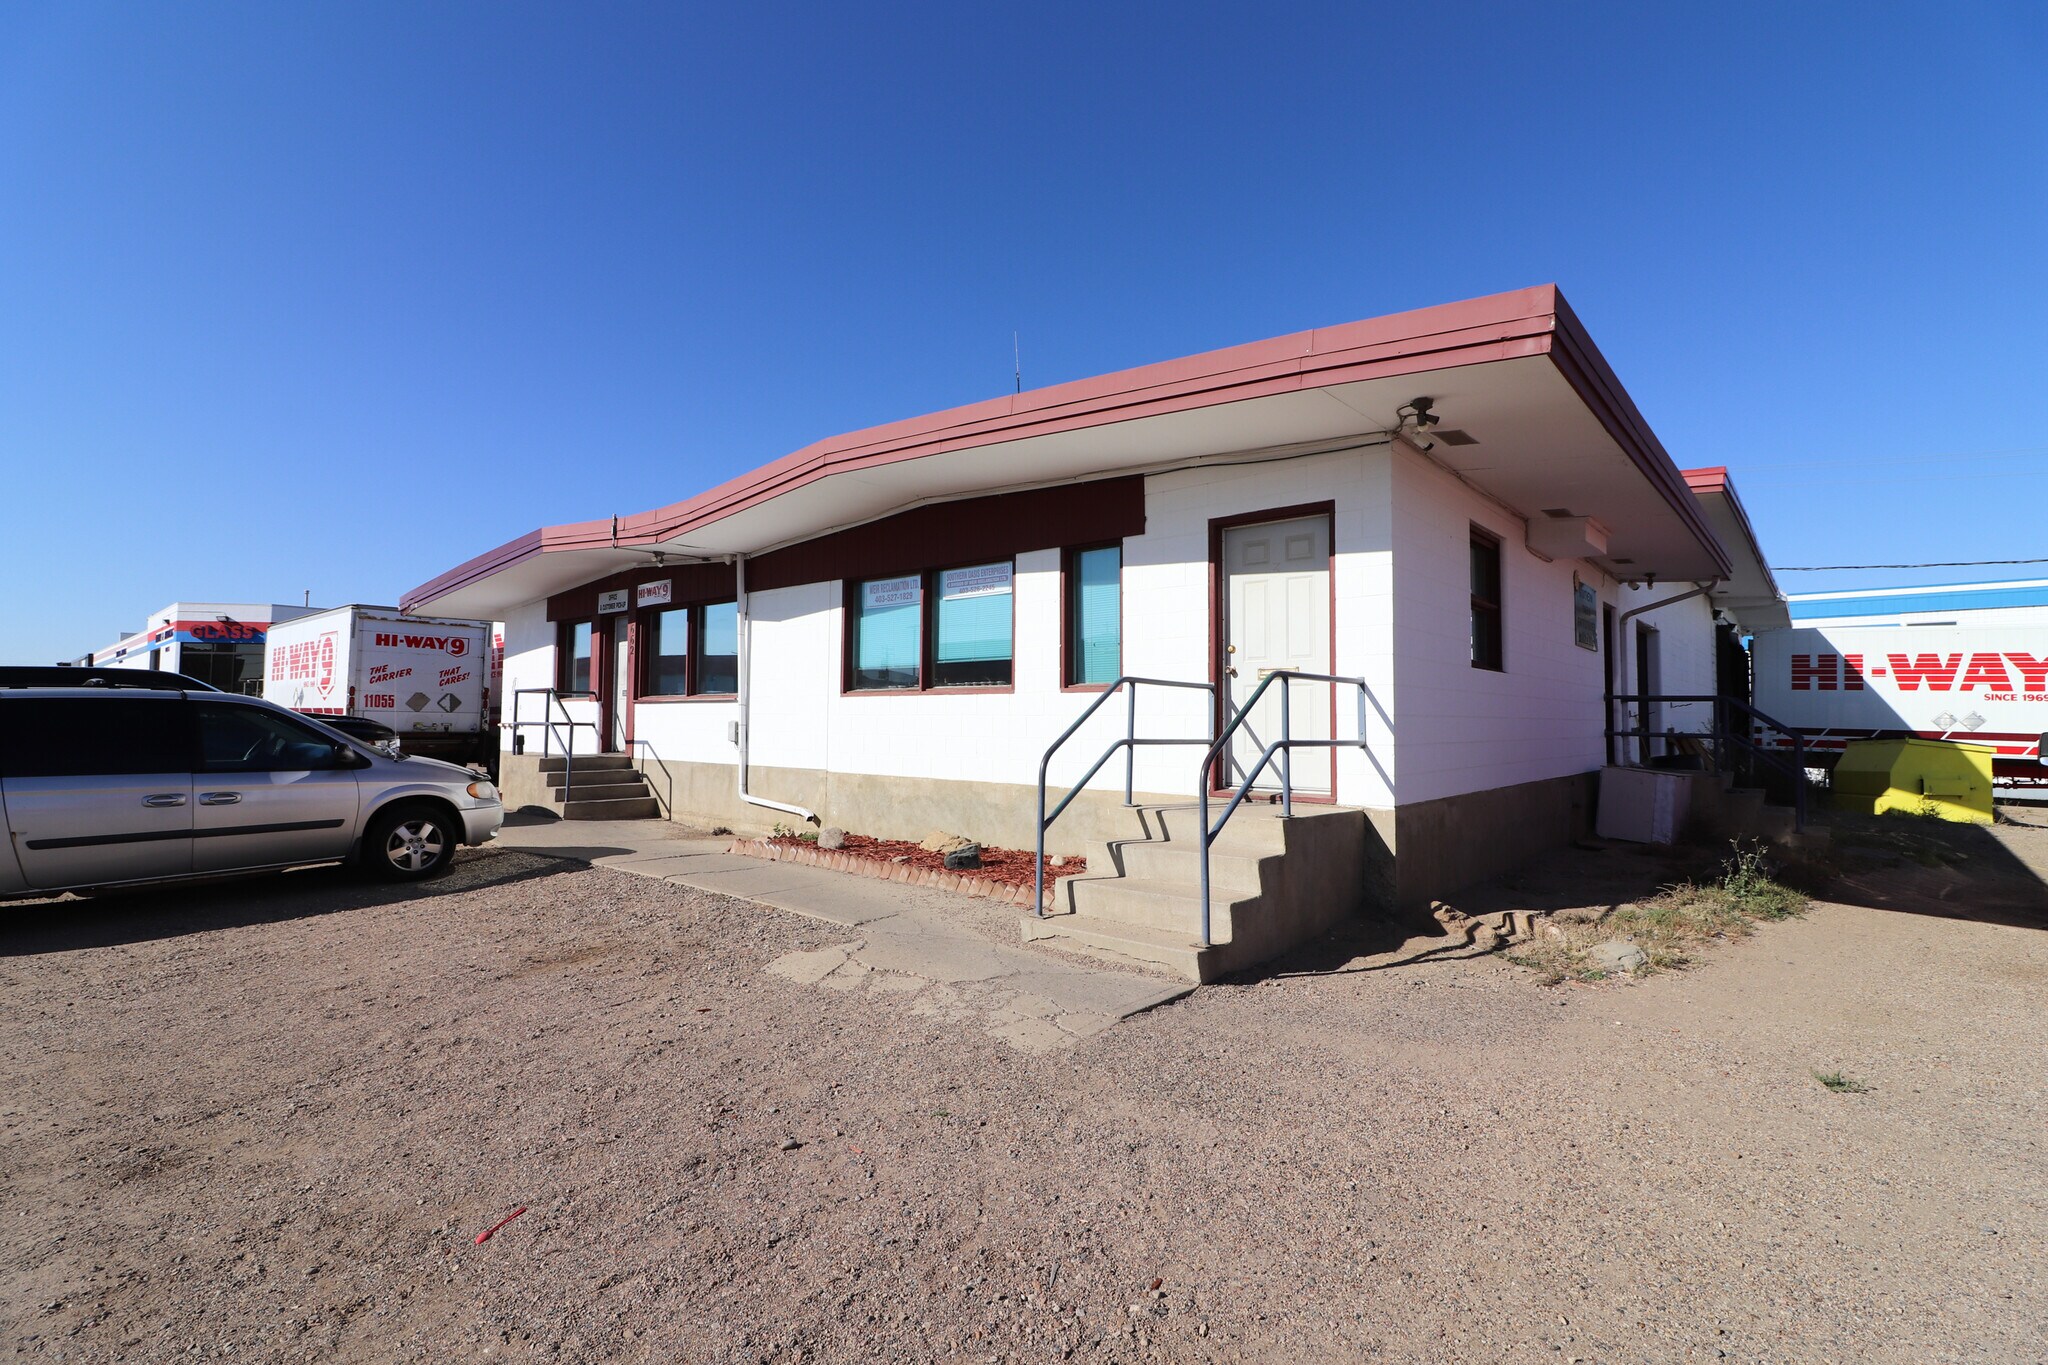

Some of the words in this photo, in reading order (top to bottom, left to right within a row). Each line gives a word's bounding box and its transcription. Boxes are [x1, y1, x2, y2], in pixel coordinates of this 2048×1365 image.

[638, 585, 662, 599] HI-WAY
[662, 584, 669, 596] 9
[190, 624, 254, 639] GLASS
[375, 633, 449, 650] HI-WAY
[450, 638, 465, 655] 9
[271, 639, 321, 681] HI-WAY
[321, 636, 333, 690] 9
[369, 664, 389, 676] THE
[369, 667, 413, 685] CARRIER
[438, 671, 471, 688] CARES!
[439, 666, 462, 679] THAT
[1791, 652, 2048, 692] HI-WAY
[364, 693, 395, 709] 11055
[1984, 693, 2018, 702] SINCE
[2022, 693, 2048, 702] 1969
